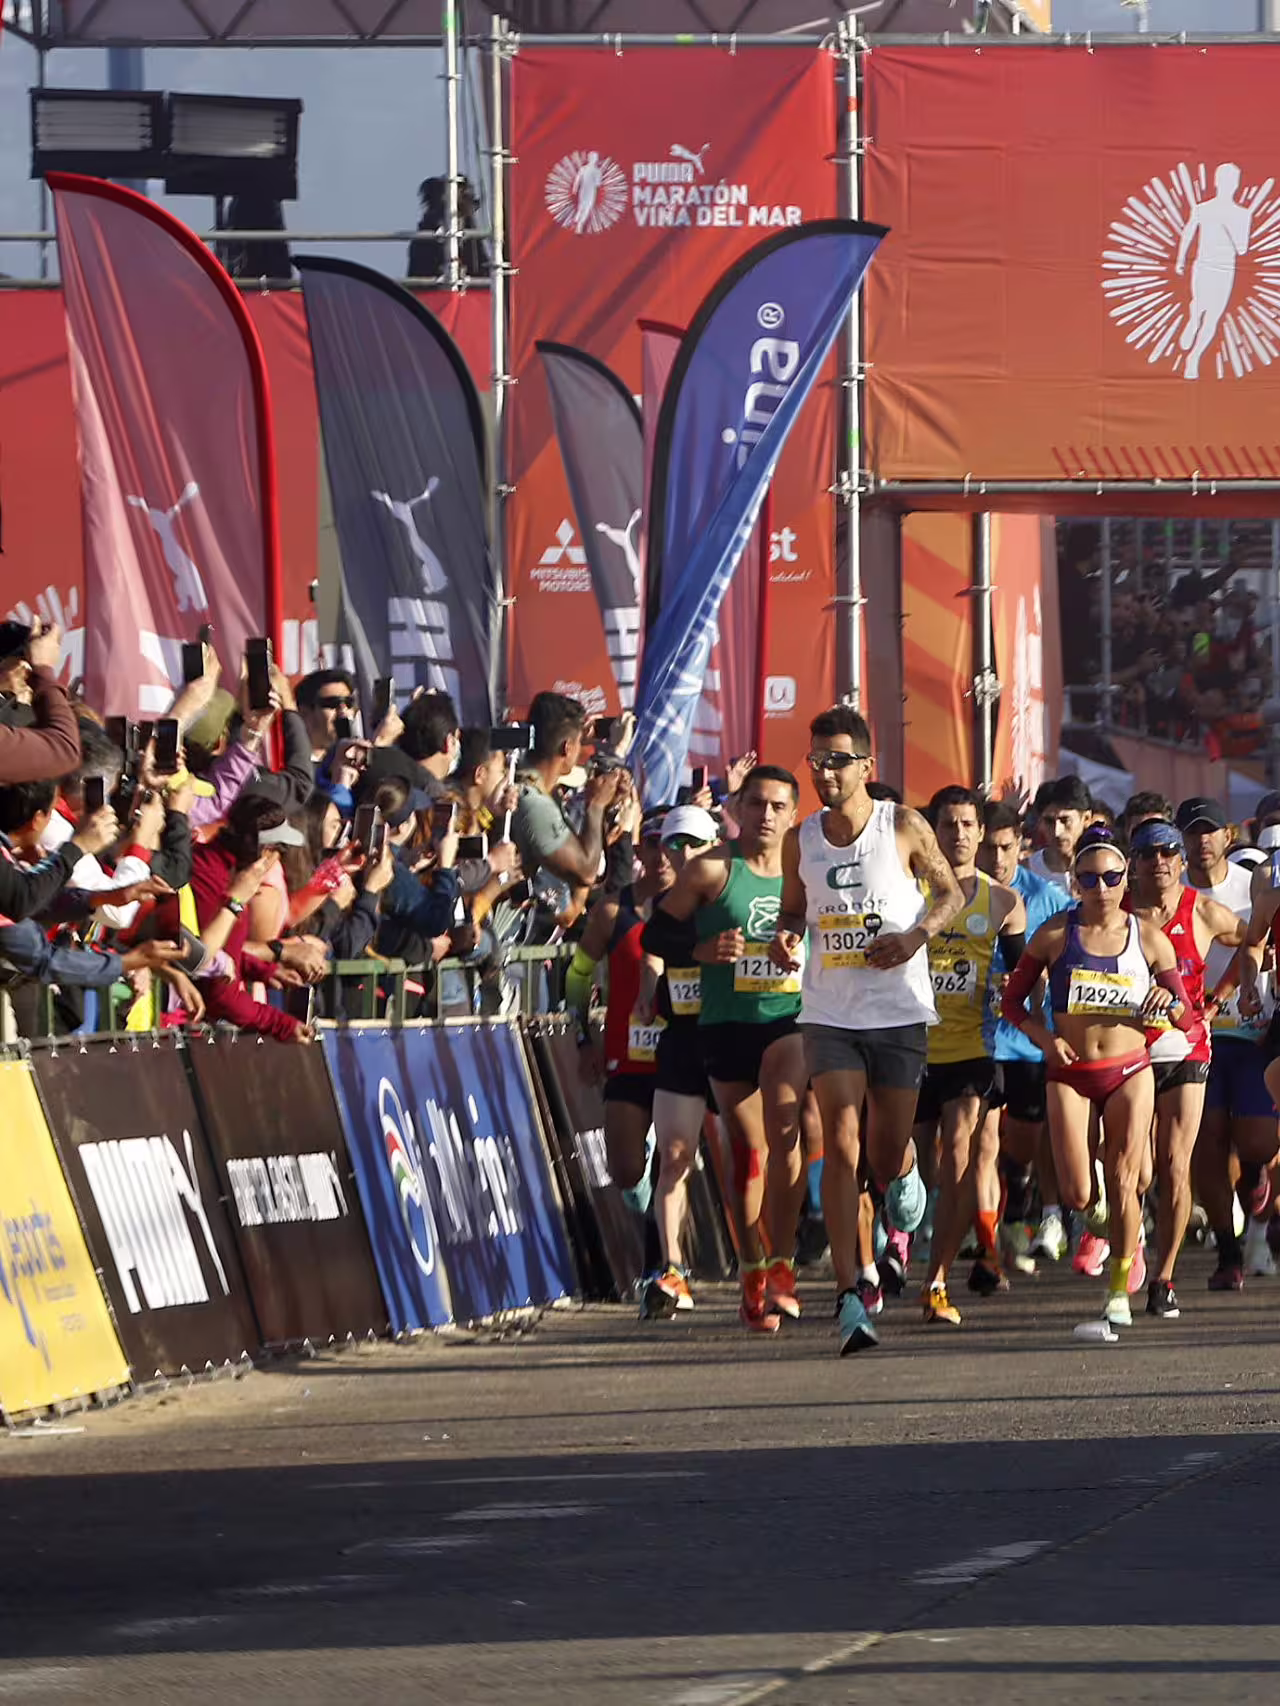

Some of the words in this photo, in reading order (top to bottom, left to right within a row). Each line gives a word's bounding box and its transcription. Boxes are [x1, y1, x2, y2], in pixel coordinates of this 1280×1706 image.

[632, 179, 749, 206] MARATÓN
[633, 204, 692, 227] VIÑA
[697, 206, 744, 226] DEL
[749, 206, 802, 226] MAR
[1075, 985, 1130, 1007] 12924
